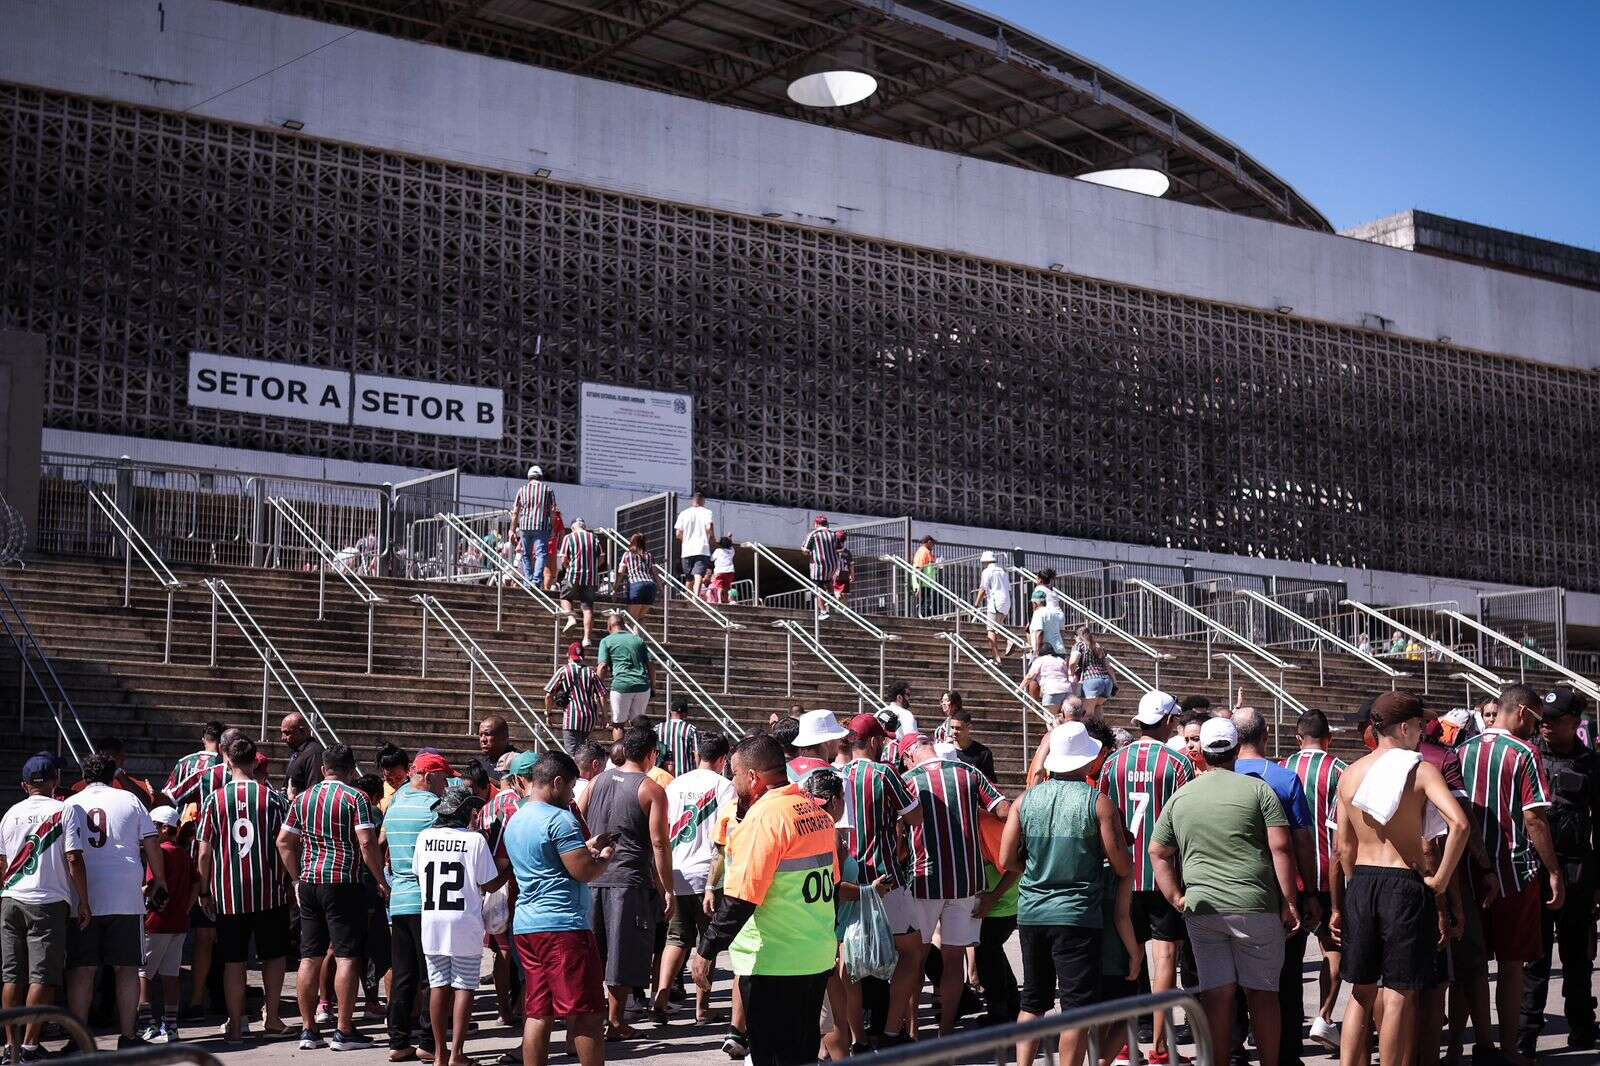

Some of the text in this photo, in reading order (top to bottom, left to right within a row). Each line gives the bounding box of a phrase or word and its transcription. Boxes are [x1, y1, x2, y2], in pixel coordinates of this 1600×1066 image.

[196, 368, 342, 409] SETOR A
[361, 390, 495, 424] SETOR B
[86, 807, 107, 848] 9
[1128, 792, 1150, 839] 7
[233, 818, 254, 858] 9
[424, 839, 469, 853] MIGUEL
[423, 861, 465, 911] 12
